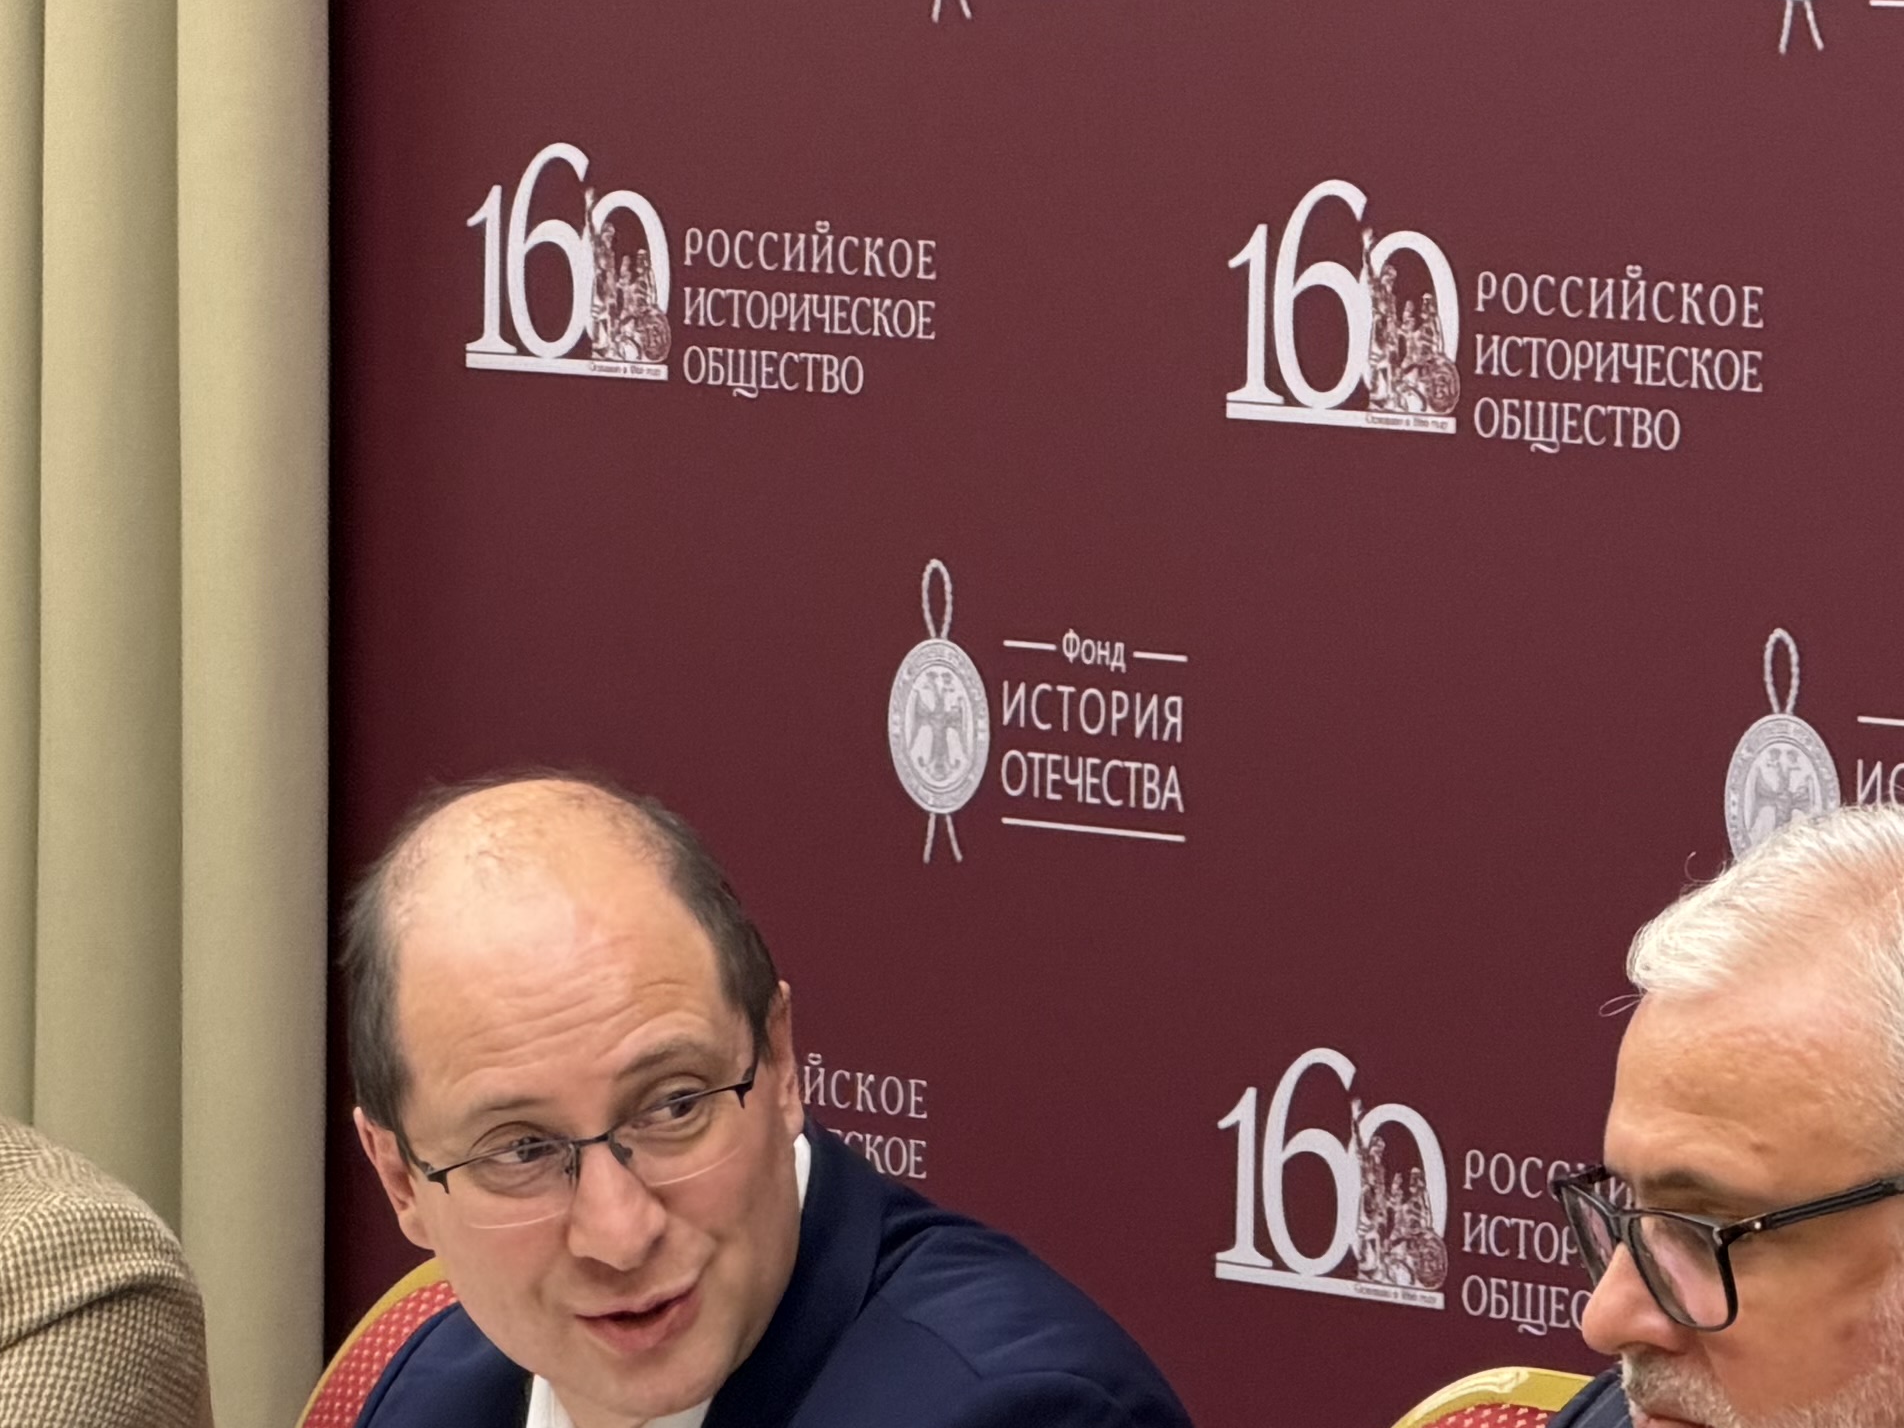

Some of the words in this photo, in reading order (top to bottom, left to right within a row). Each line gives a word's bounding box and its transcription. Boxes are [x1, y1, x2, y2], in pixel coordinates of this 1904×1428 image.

[683, 220, 938, 281] РОССИЙСКОЕ
[682, 286, 936, 340] ИСТОРИЧЕСКОЕ
[1474, 264, 1765, 330] РОССИЙСКОЕ
[682, 345, 865, 399] ОБЩЕСТВО
[1474, 332, 1764, 394] ИСТОРИЧЕСКОЕ
[1473, 396, 1681, 454] ОБЩЕСТВО
[1062, 628, 1127, 674] Фонд
[1002, 680, 1184, 743] ИСТОРИЯ
[1001, 749, 1185, 813] ОТЕЧЕСТВА
[1461, 1274, 1594, 1336] ОБЩЕС
